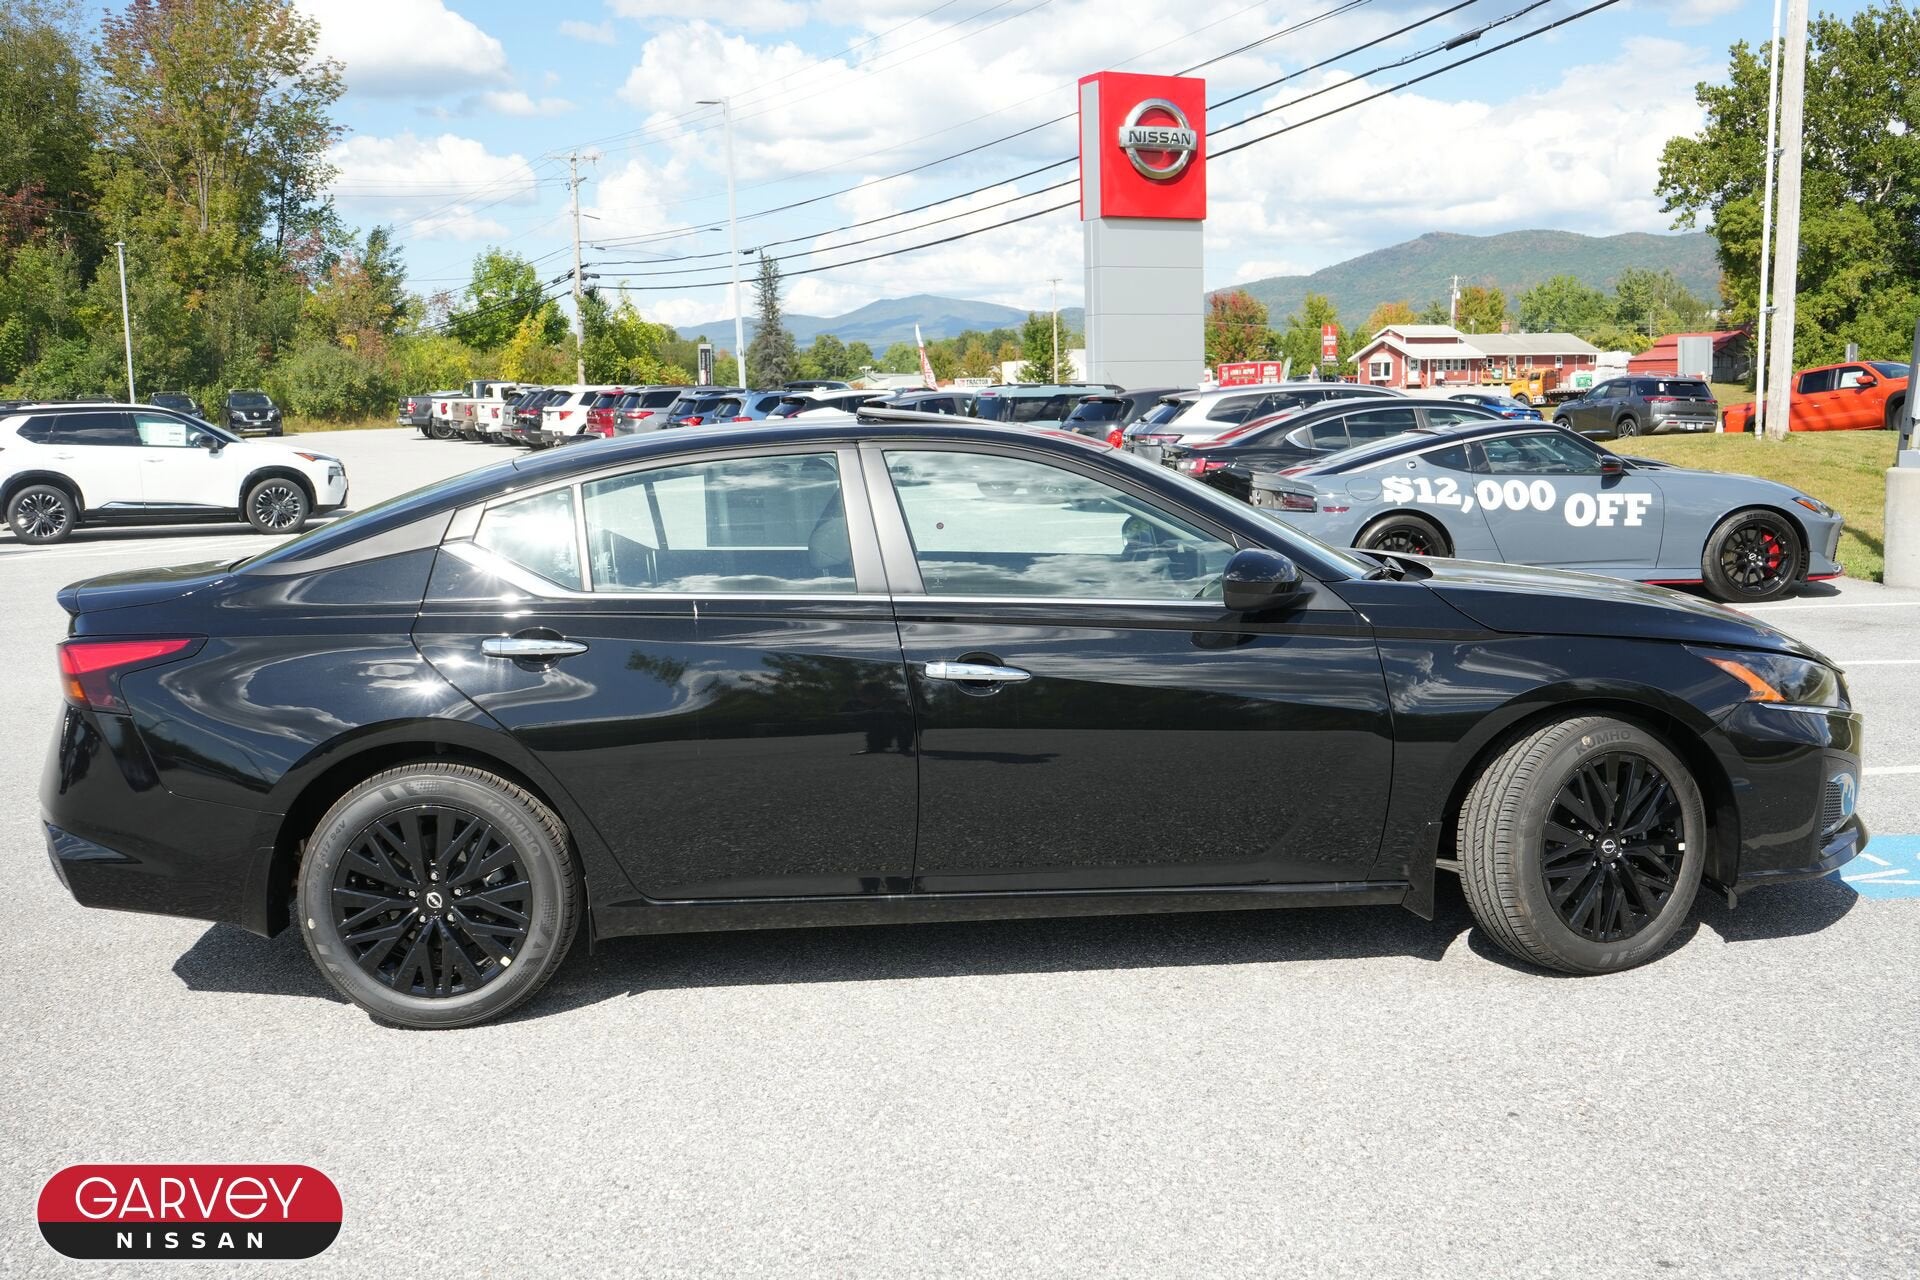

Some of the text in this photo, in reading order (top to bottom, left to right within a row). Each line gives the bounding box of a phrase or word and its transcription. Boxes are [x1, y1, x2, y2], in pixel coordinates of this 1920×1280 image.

[1128, 130, 1191, 146] NISSAN
[1382, 476, 1652, 527] $12,000 OFF
